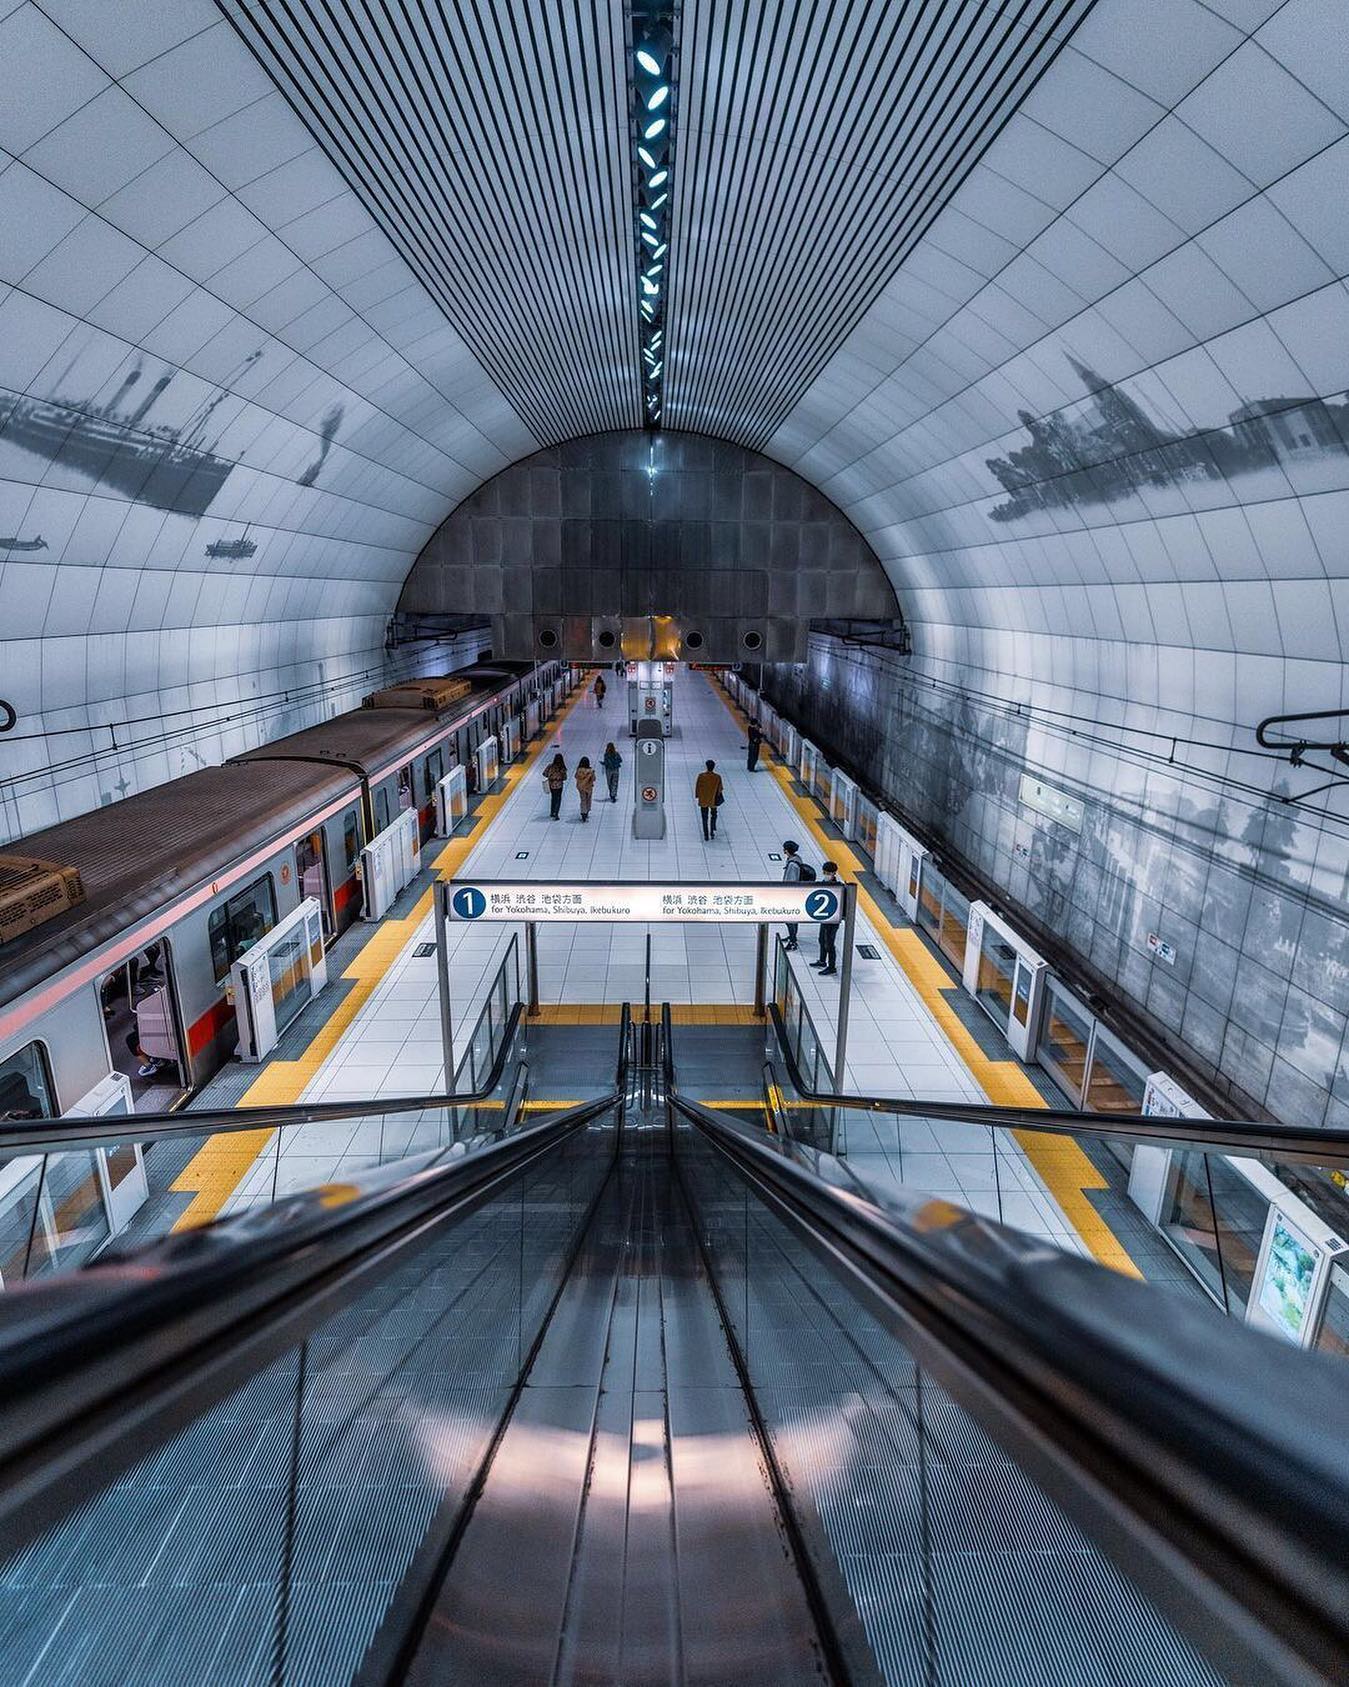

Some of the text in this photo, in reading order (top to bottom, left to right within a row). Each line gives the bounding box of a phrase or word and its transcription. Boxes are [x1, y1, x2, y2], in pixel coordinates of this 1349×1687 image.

[463, 892, 473, 915] 1
[491, 894, 511, 904] 横浜
[516, 894, 536, 904] 渋谷
[663, 895, 682, 905] 横浜
[687, 895, 708, 905] 渋谷
[491, 905, 503, 914] for
[505, 905, 550, 915] Yokohama,
[590, 905, 631, 914] Ikebukuro
[814, 894, 829, 916] 2
[663, 906, 675, 915] for
[677, 906, 721, 916] Yokohama,
[724, 906, 758, 916] Shibuya,
